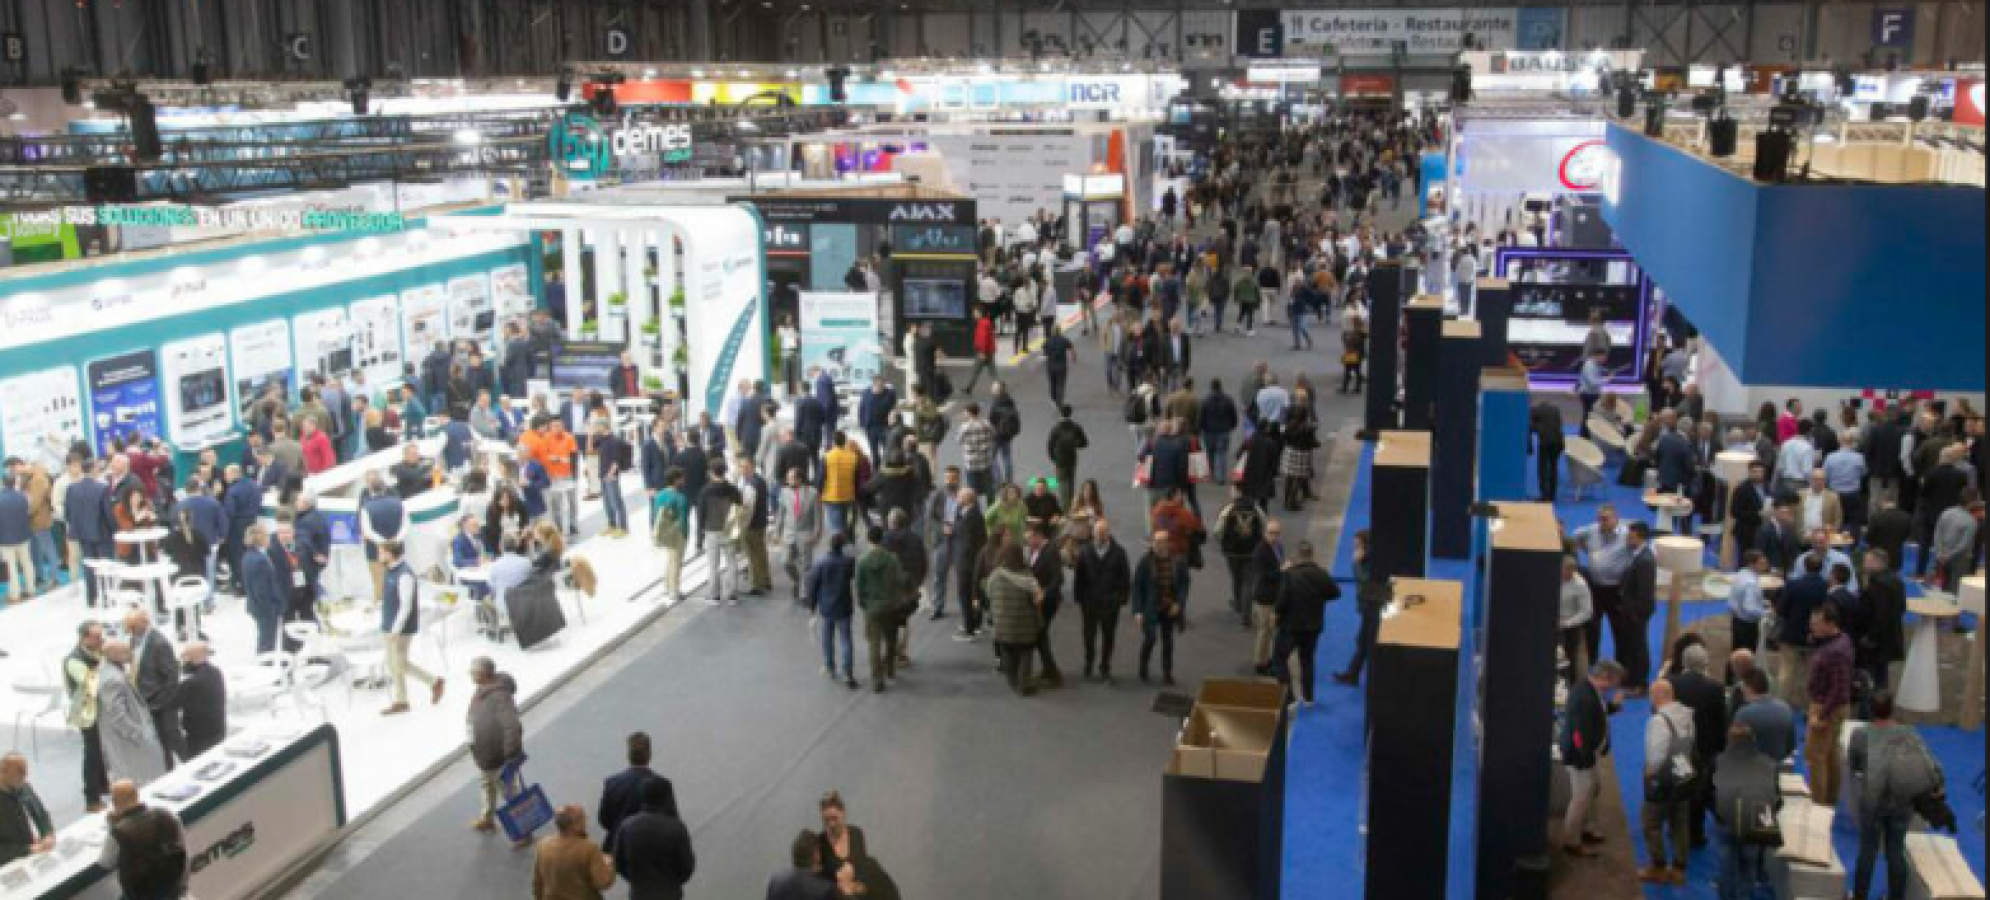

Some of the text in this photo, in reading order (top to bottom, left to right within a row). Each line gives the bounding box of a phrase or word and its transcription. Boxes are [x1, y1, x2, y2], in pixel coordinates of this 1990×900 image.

[608, 30, 627, 54] D
[1258, 28, 1275, 54] E
[1882, 14, 1902, 43] F
[293, 36, 310, 59] C
[613, 110, 692, 156] demes
[190, 820, 255, 873] emes
